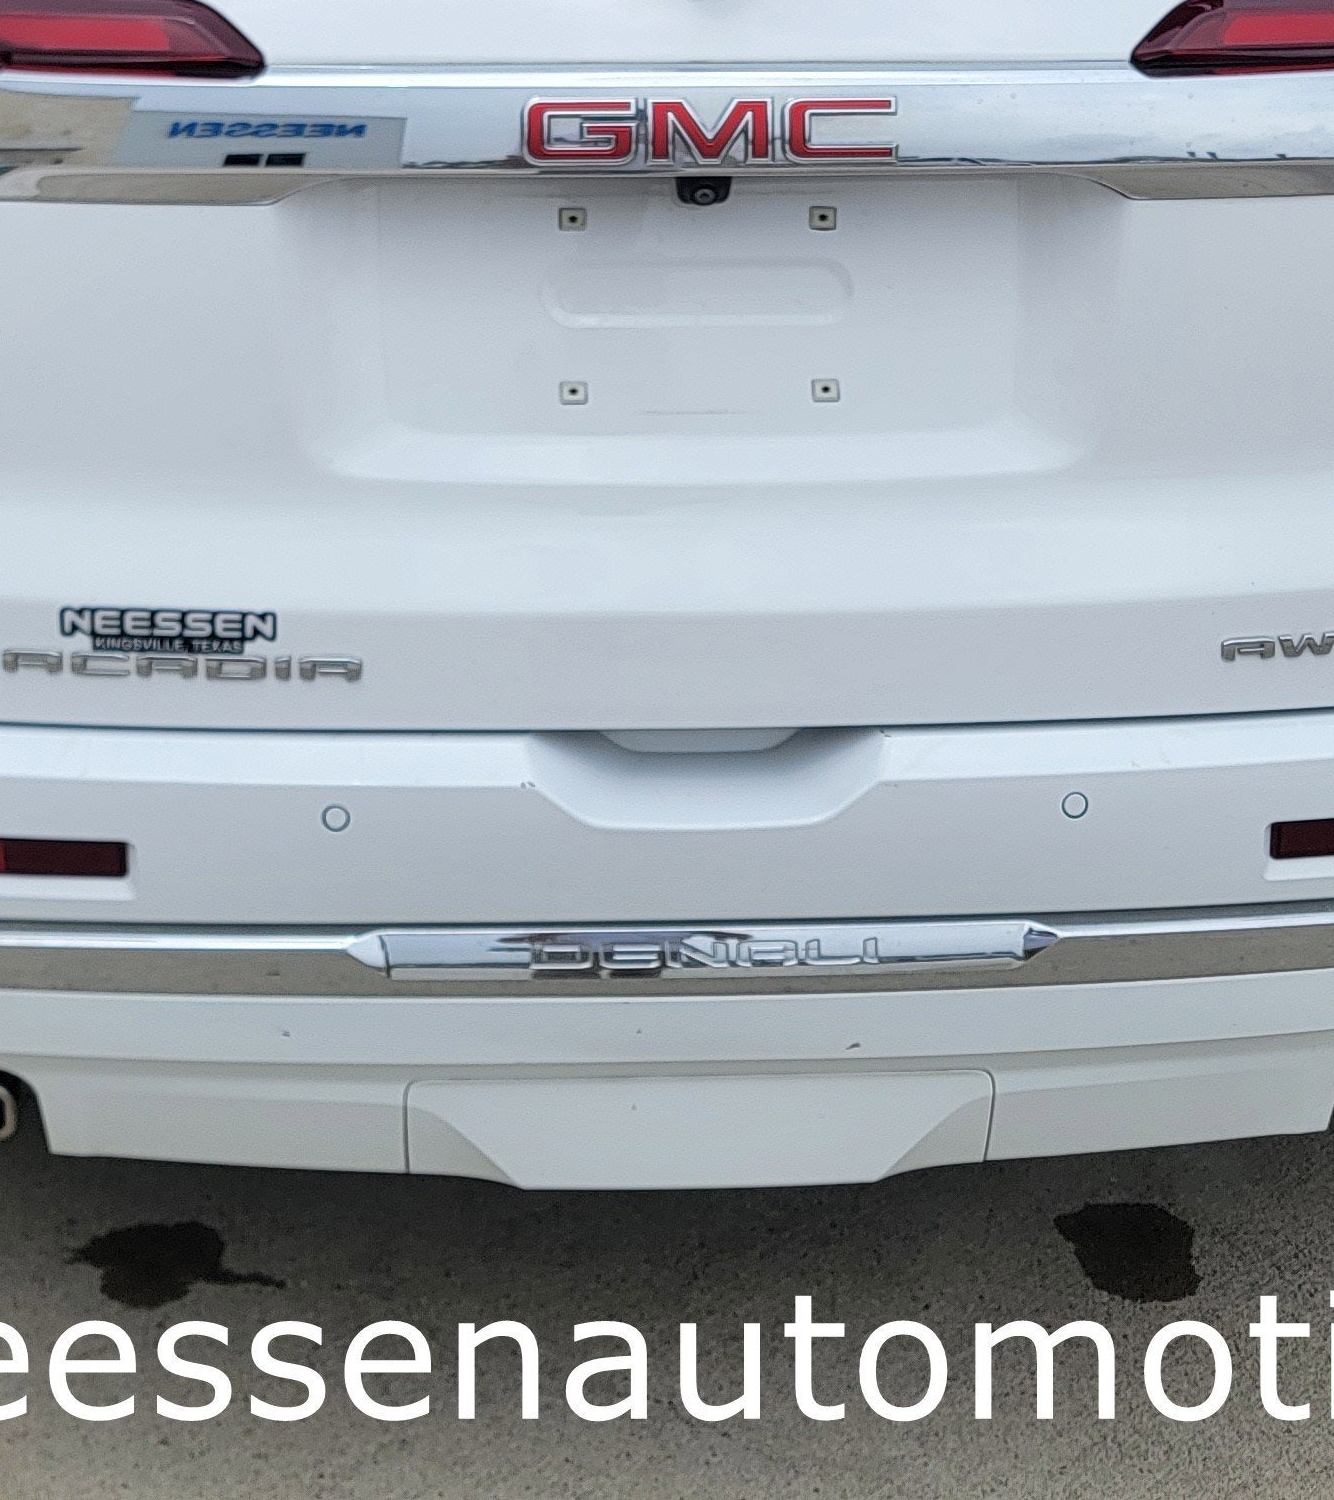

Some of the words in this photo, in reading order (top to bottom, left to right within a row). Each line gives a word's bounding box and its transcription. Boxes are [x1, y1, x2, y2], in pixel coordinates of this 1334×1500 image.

[522, 96, 898, 166] GMC
[60, 607, 276, 640] NEESSEN
[94, 636, 189, 651] KINGSVILLE,
[192, 639, 244, 653] TEXAS
[2, 649, 363, 682] ACADIA
[529, 937, 879, 970] DENALI
